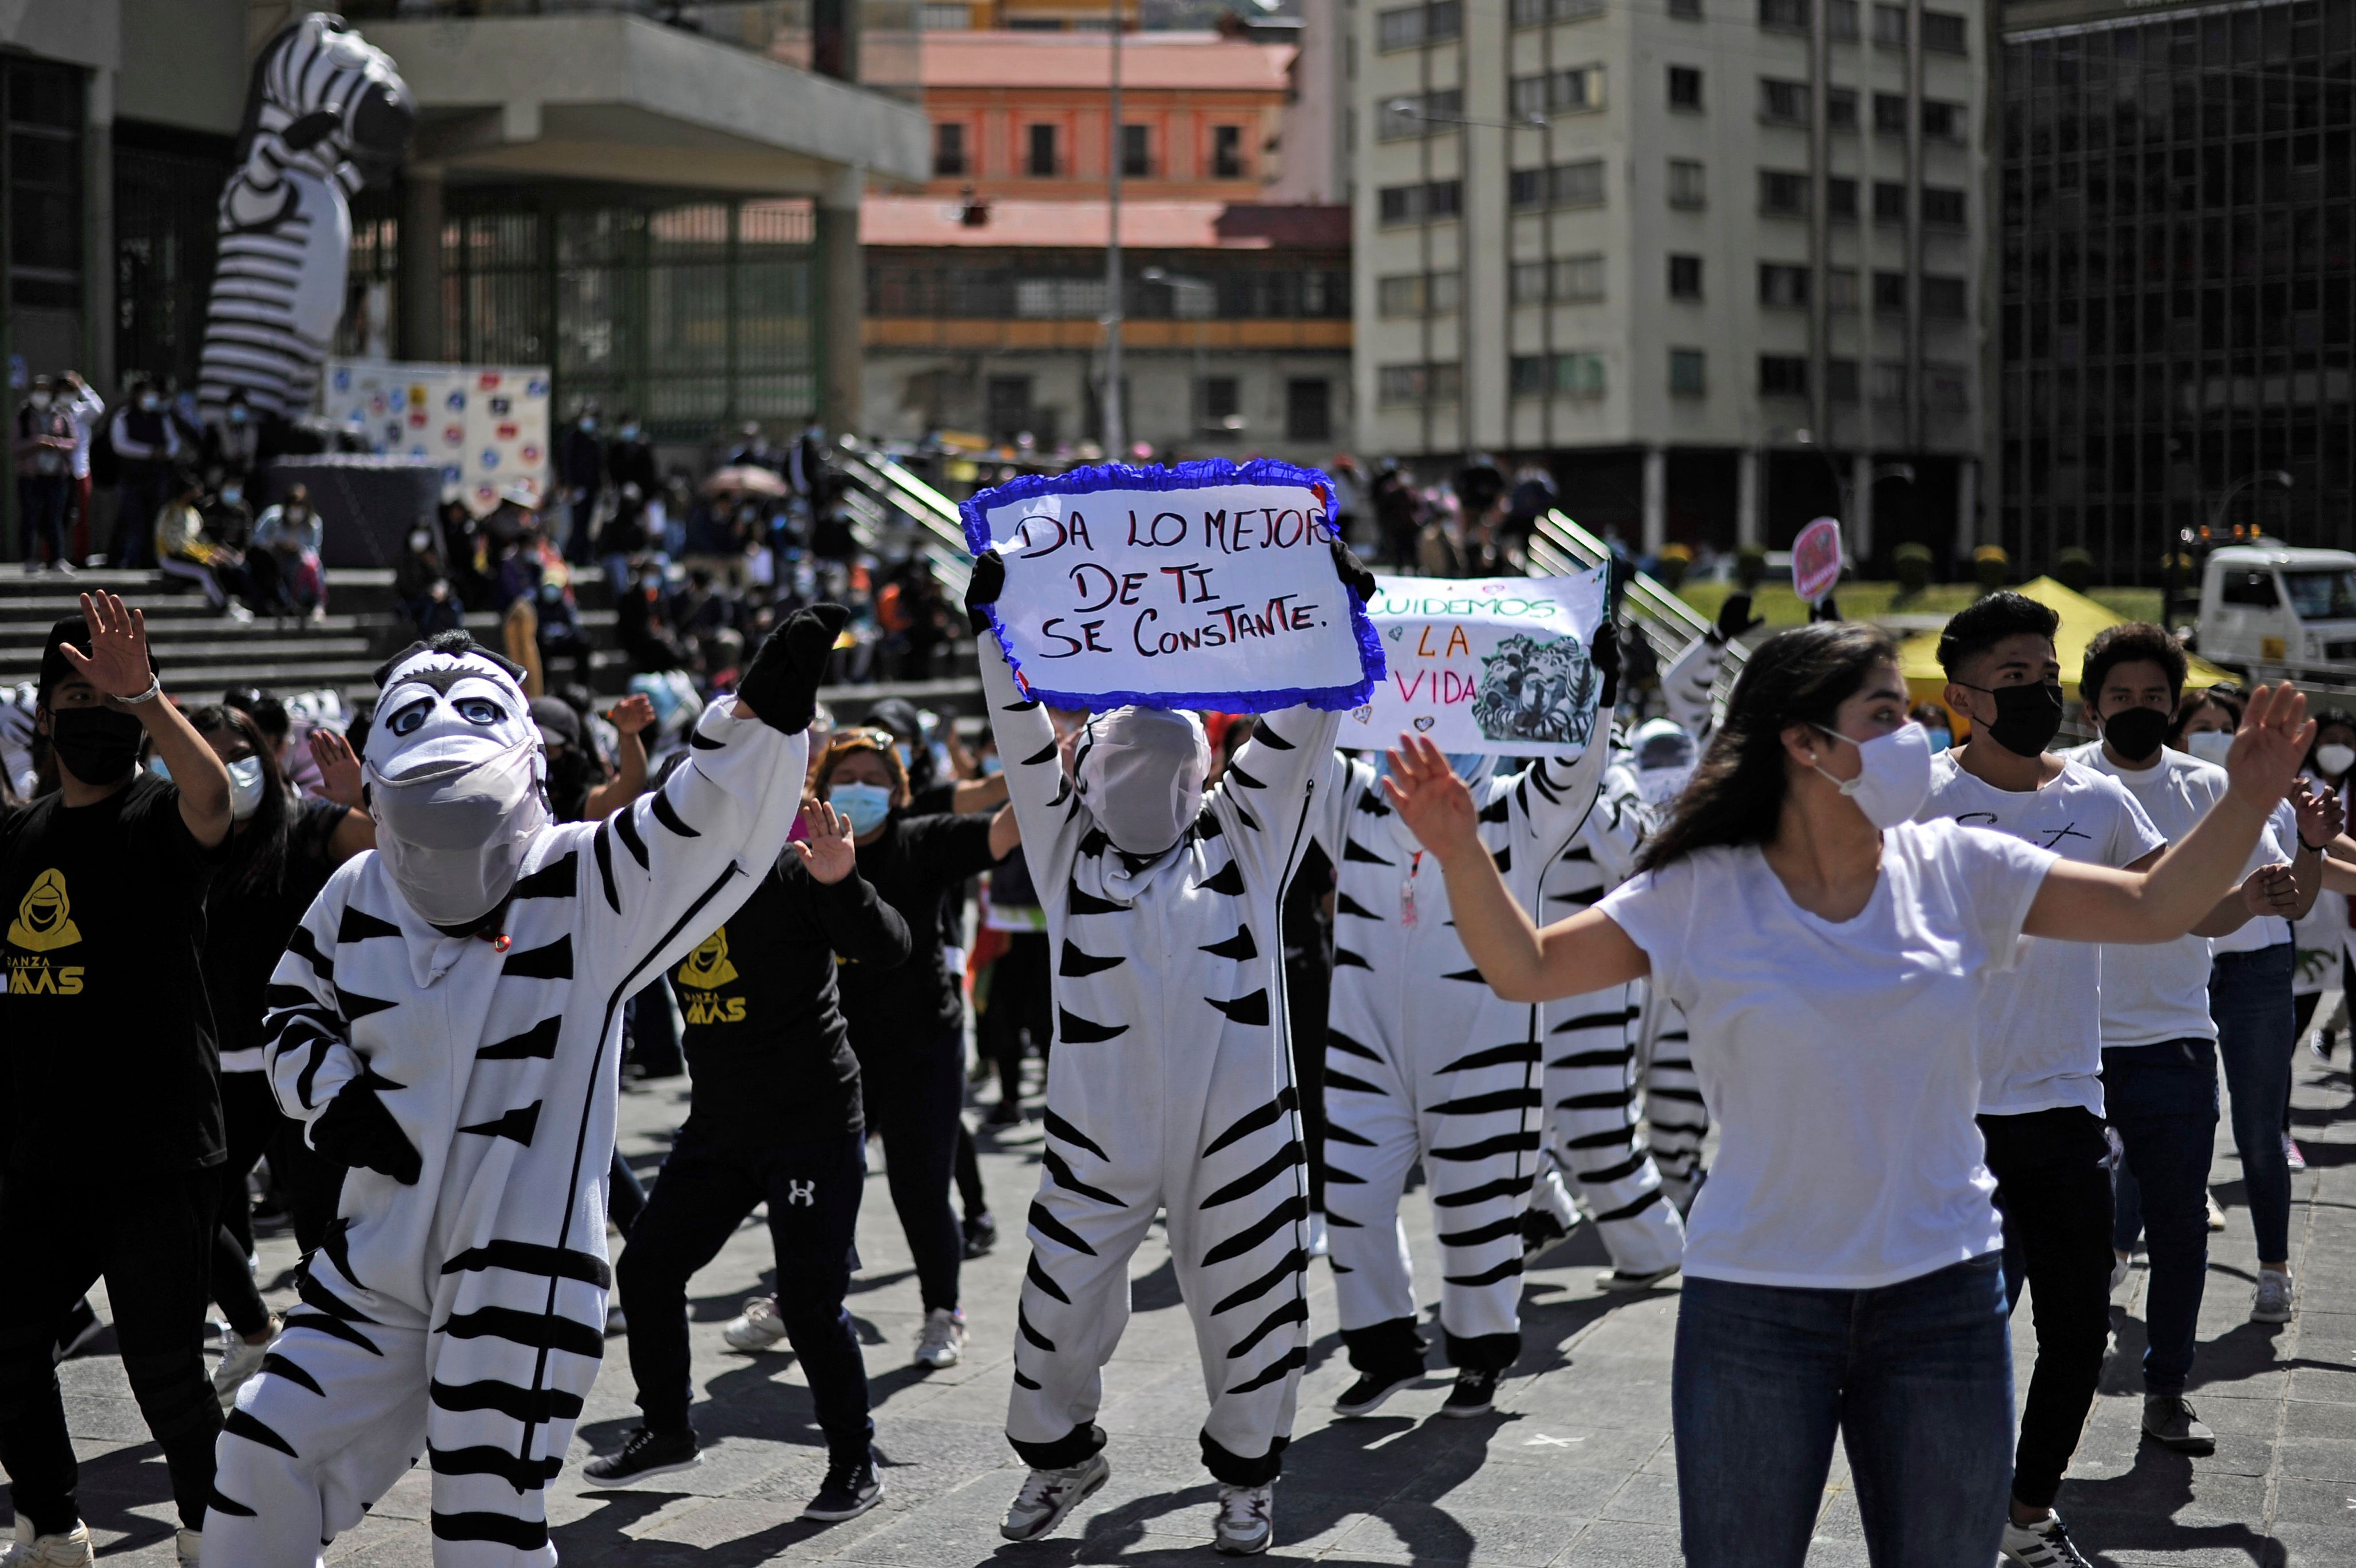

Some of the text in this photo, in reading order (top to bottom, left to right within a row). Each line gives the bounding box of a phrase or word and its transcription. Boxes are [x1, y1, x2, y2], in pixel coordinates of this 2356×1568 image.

[1015, 508, 1331, 559] DA LO MEJOR
[1069, 563, 1220, 613] DE TI
[1039, 594, 1327, 658] SE CONSTANTE.
[1417, 625, 1469, 658] LA
[1395, 670, 1477, 704] VIDA
[7, 955, 50, 967] DANZA
[8, 966, 85, 995] MAS
[687, 997, 746, 1024] MAS
